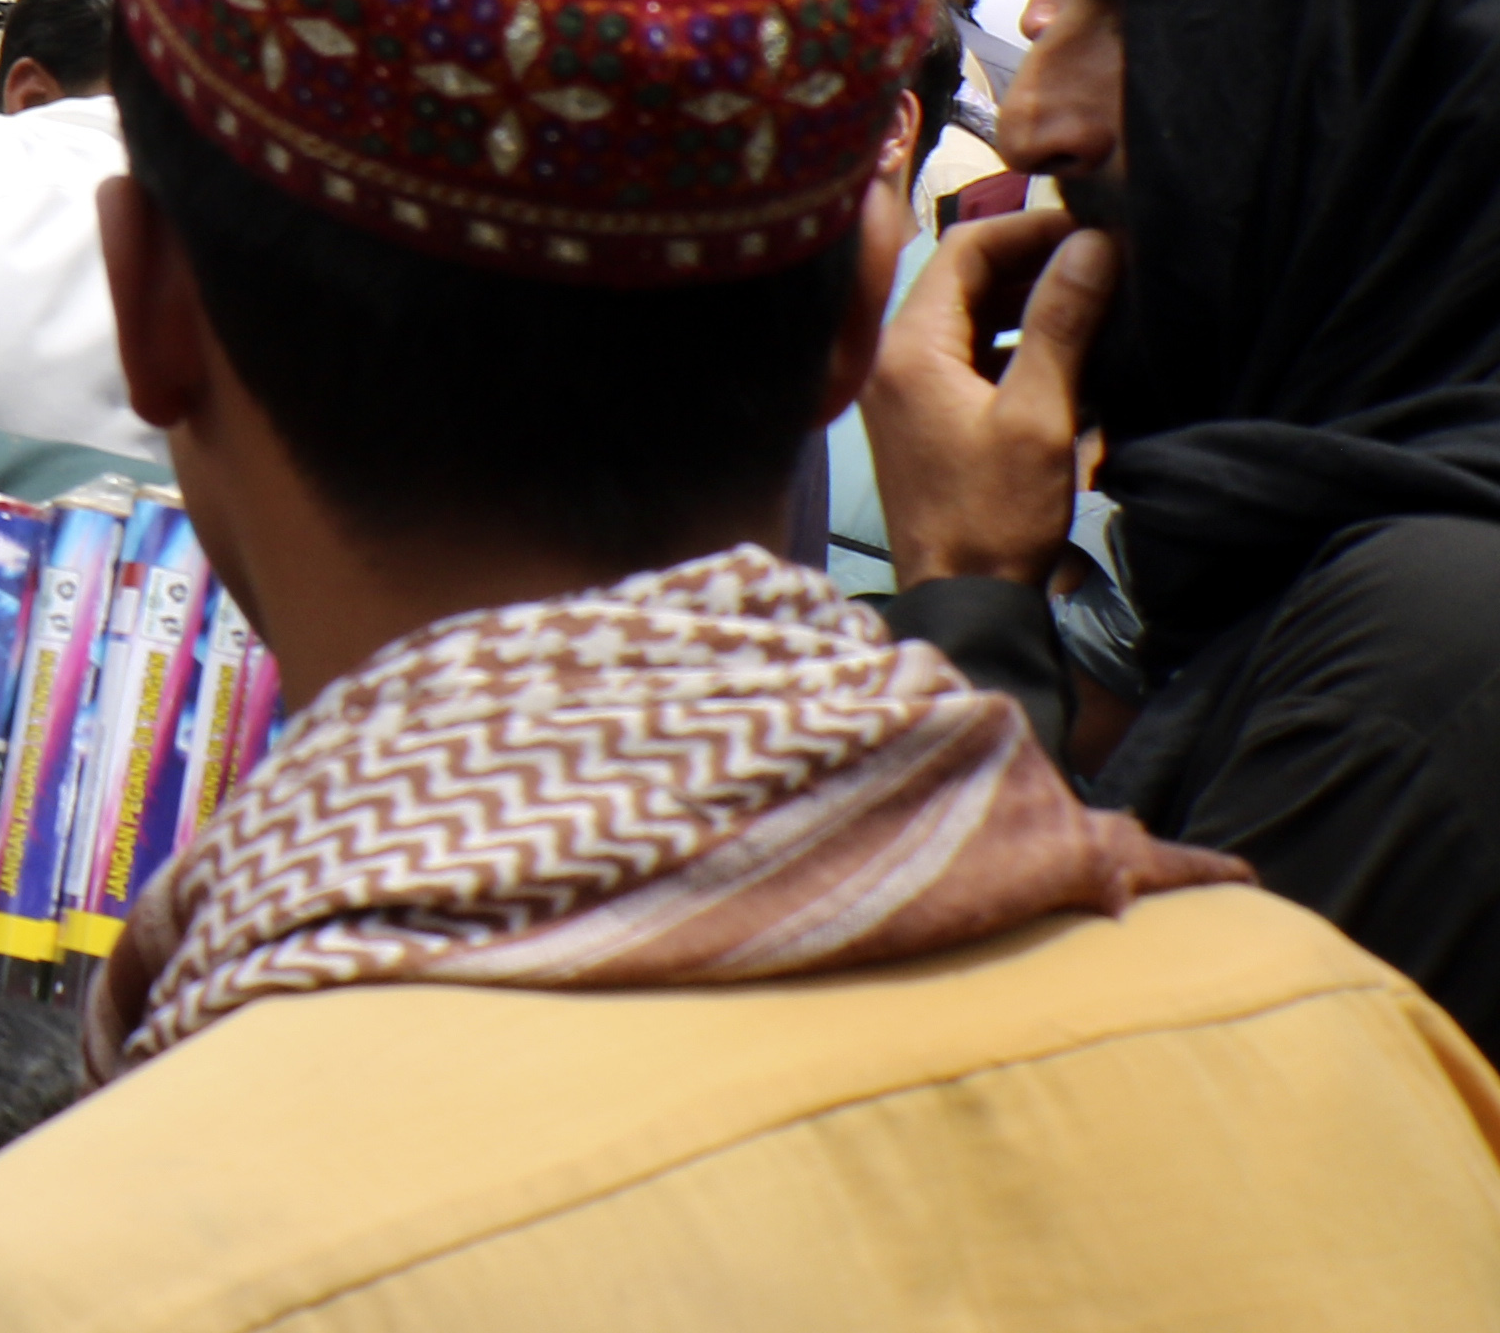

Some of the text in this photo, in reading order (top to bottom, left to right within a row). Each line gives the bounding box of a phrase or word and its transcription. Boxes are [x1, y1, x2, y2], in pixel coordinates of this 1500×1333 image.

[0, 648, 57, 897] JANGAN PEGANG DI TANGAN
[106, 650, 168, 901] JANGAN PEGANG DI TANGAN
[211, 664, 235, 735] TANGAN
